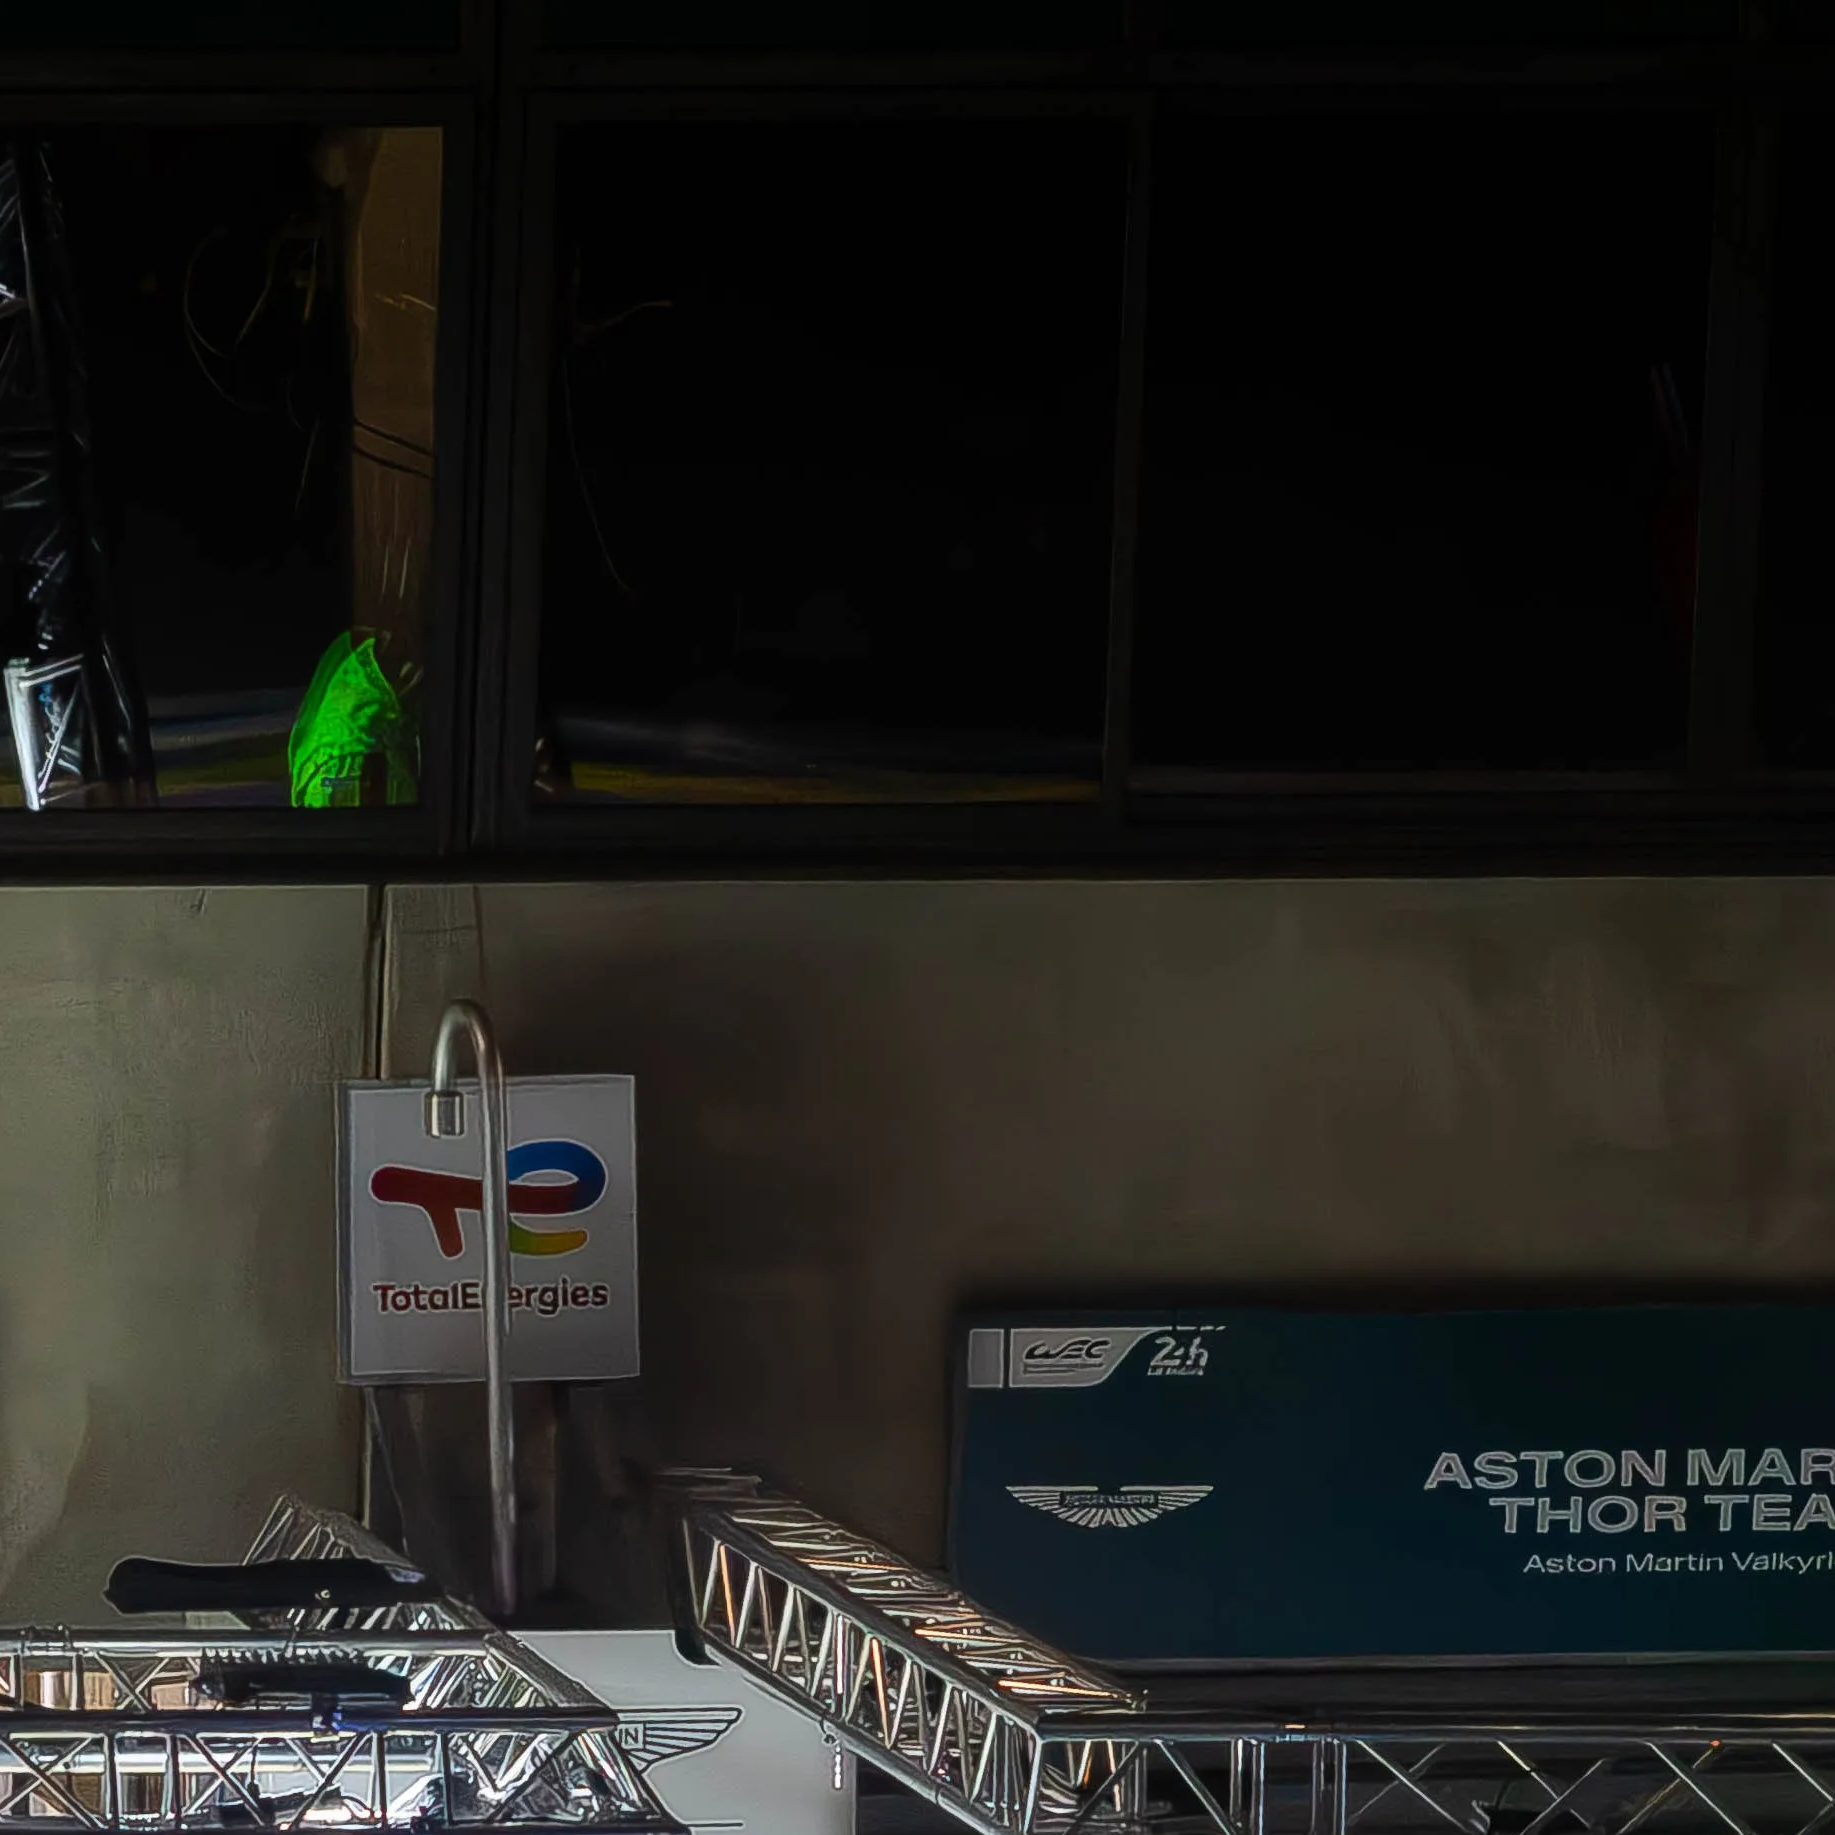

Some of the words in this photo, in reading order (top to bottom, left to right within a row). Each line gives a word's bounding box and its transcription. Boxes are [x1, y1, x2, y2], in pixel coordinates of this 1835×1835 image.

[373, 1278, 610, 1316] TotalEergies
[1423, 1449, 1667, 1490] ASTON
[1488, 1495, 1687, 1534] THOR
[1523, 1553, 1616, 1575] Aston
[1625, 1552, 1724, 1574] Martin
